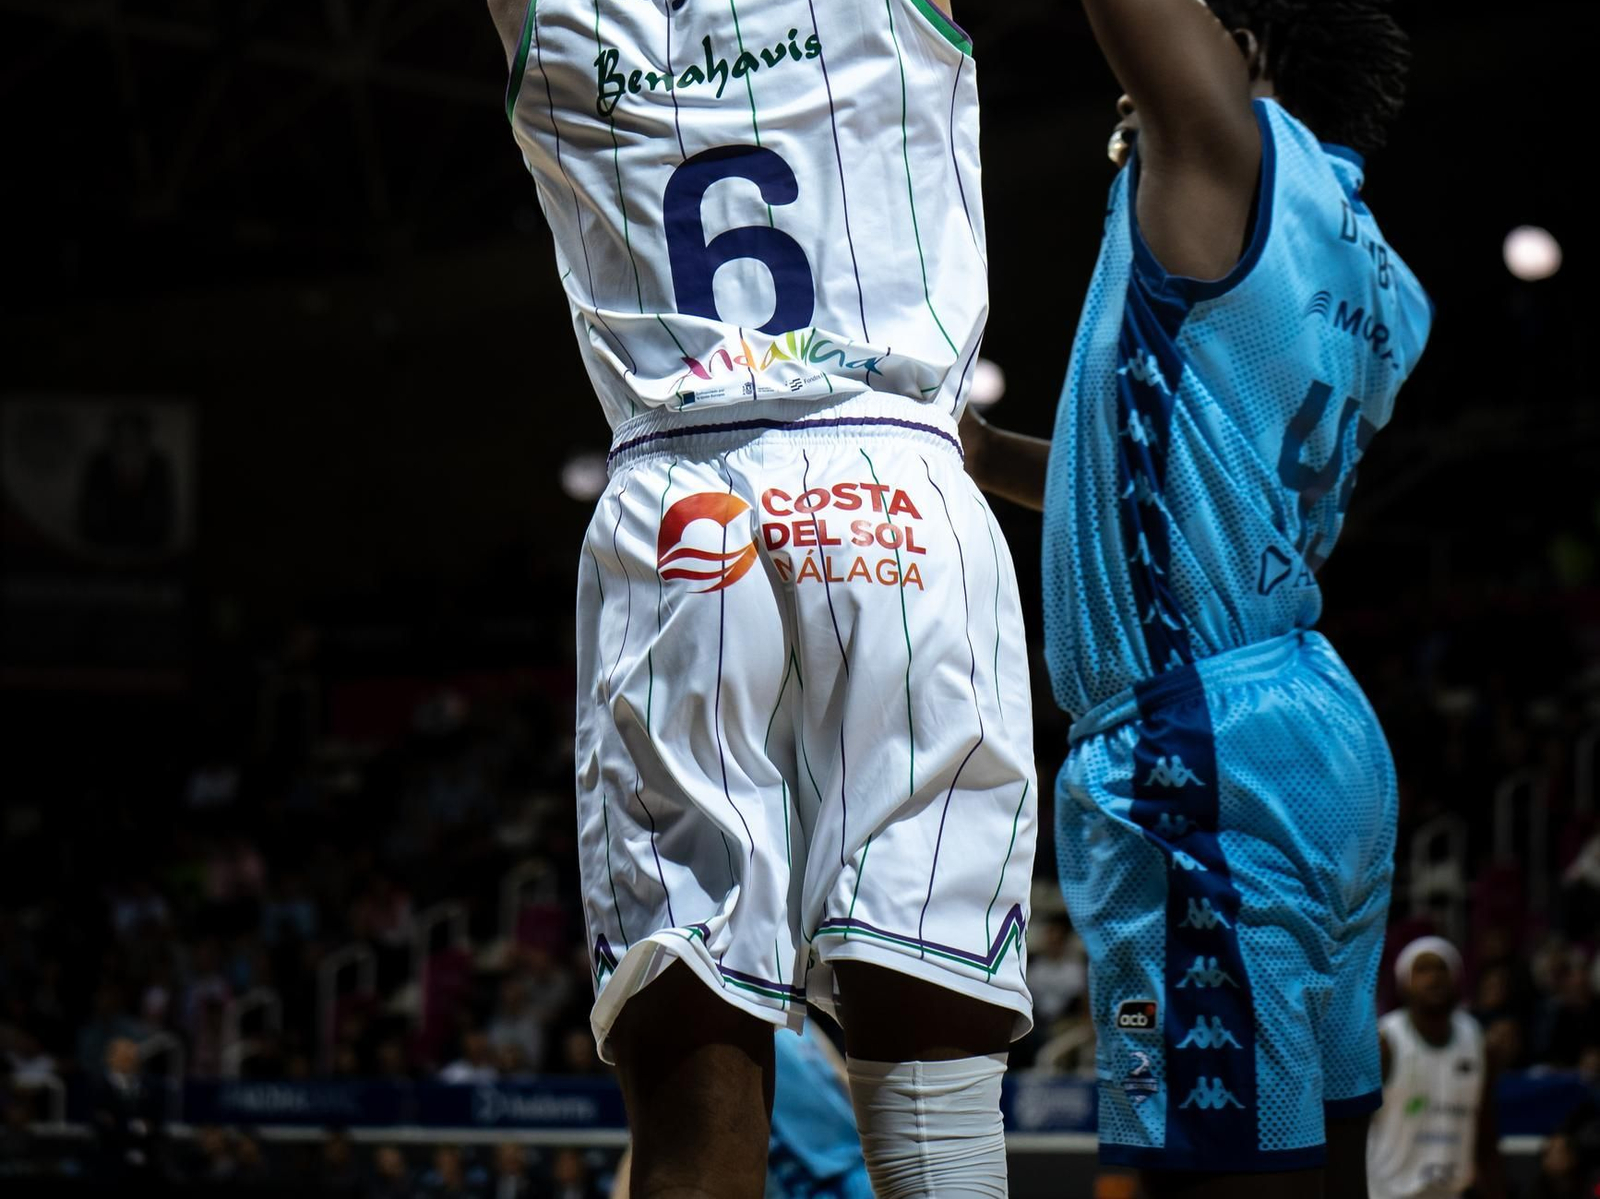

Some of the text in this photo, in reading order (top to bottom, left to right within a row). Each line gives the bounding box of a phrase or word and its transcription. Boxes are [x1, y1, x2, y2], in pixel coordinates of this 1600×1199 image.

[663, 144, 815, 336] 6
[761, 482, 923, 520] COSTA
[762, 519, 927, 555] DEL SOL
[1120, 1014, 1148, 1026] acb
